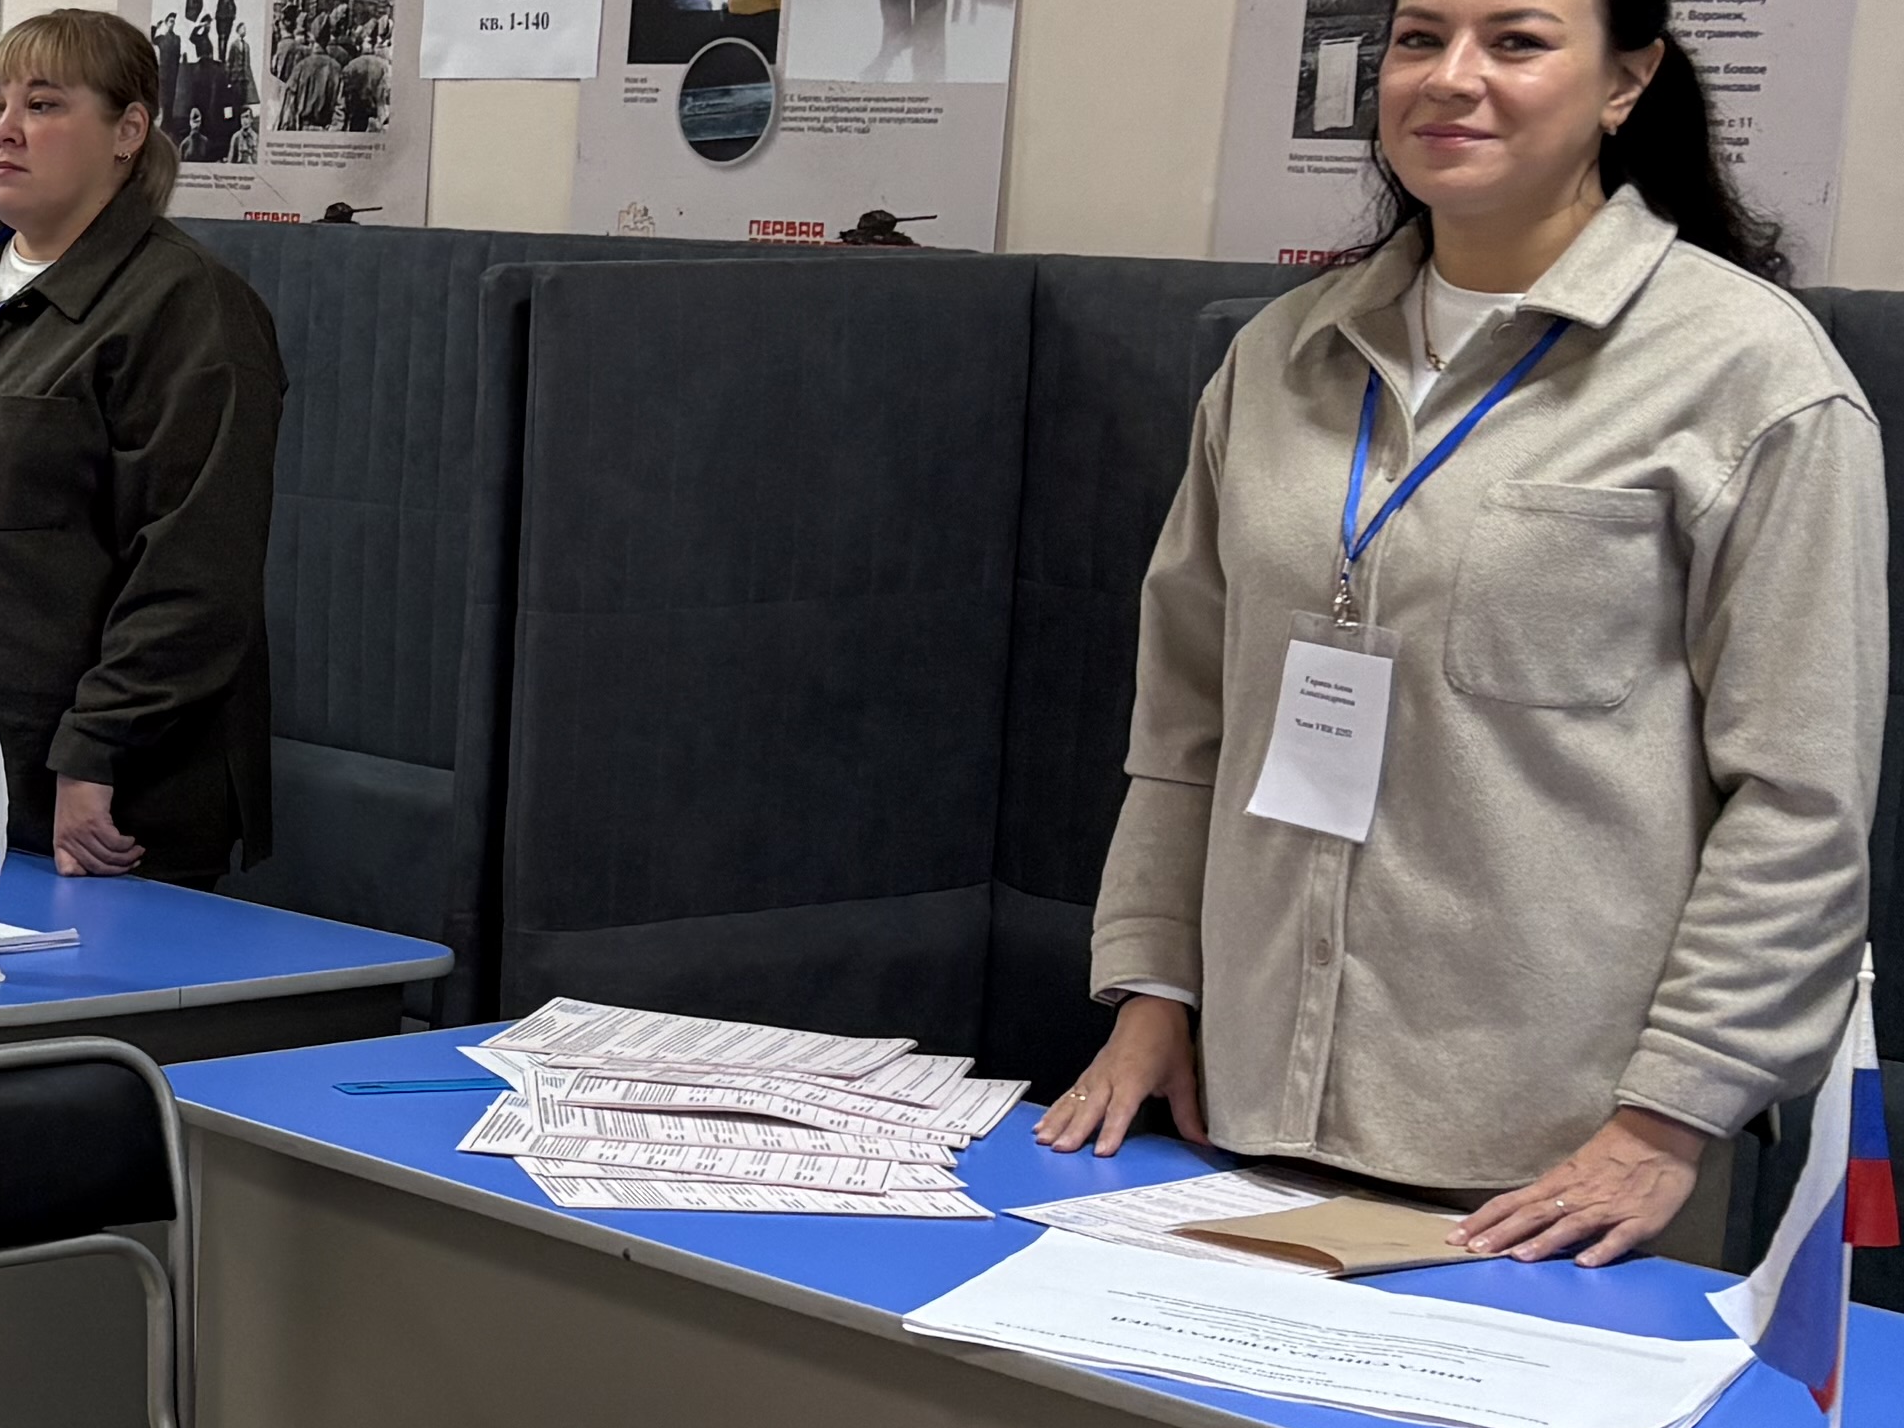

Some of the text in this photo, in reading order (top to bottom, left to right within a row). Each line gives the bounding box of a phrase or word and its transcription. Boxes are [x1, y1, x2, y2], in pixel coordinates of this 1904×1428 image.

[480, 12, 550, 30] кв. 1-140
[749, 220, 824, 238] ПЕРВАЯ
